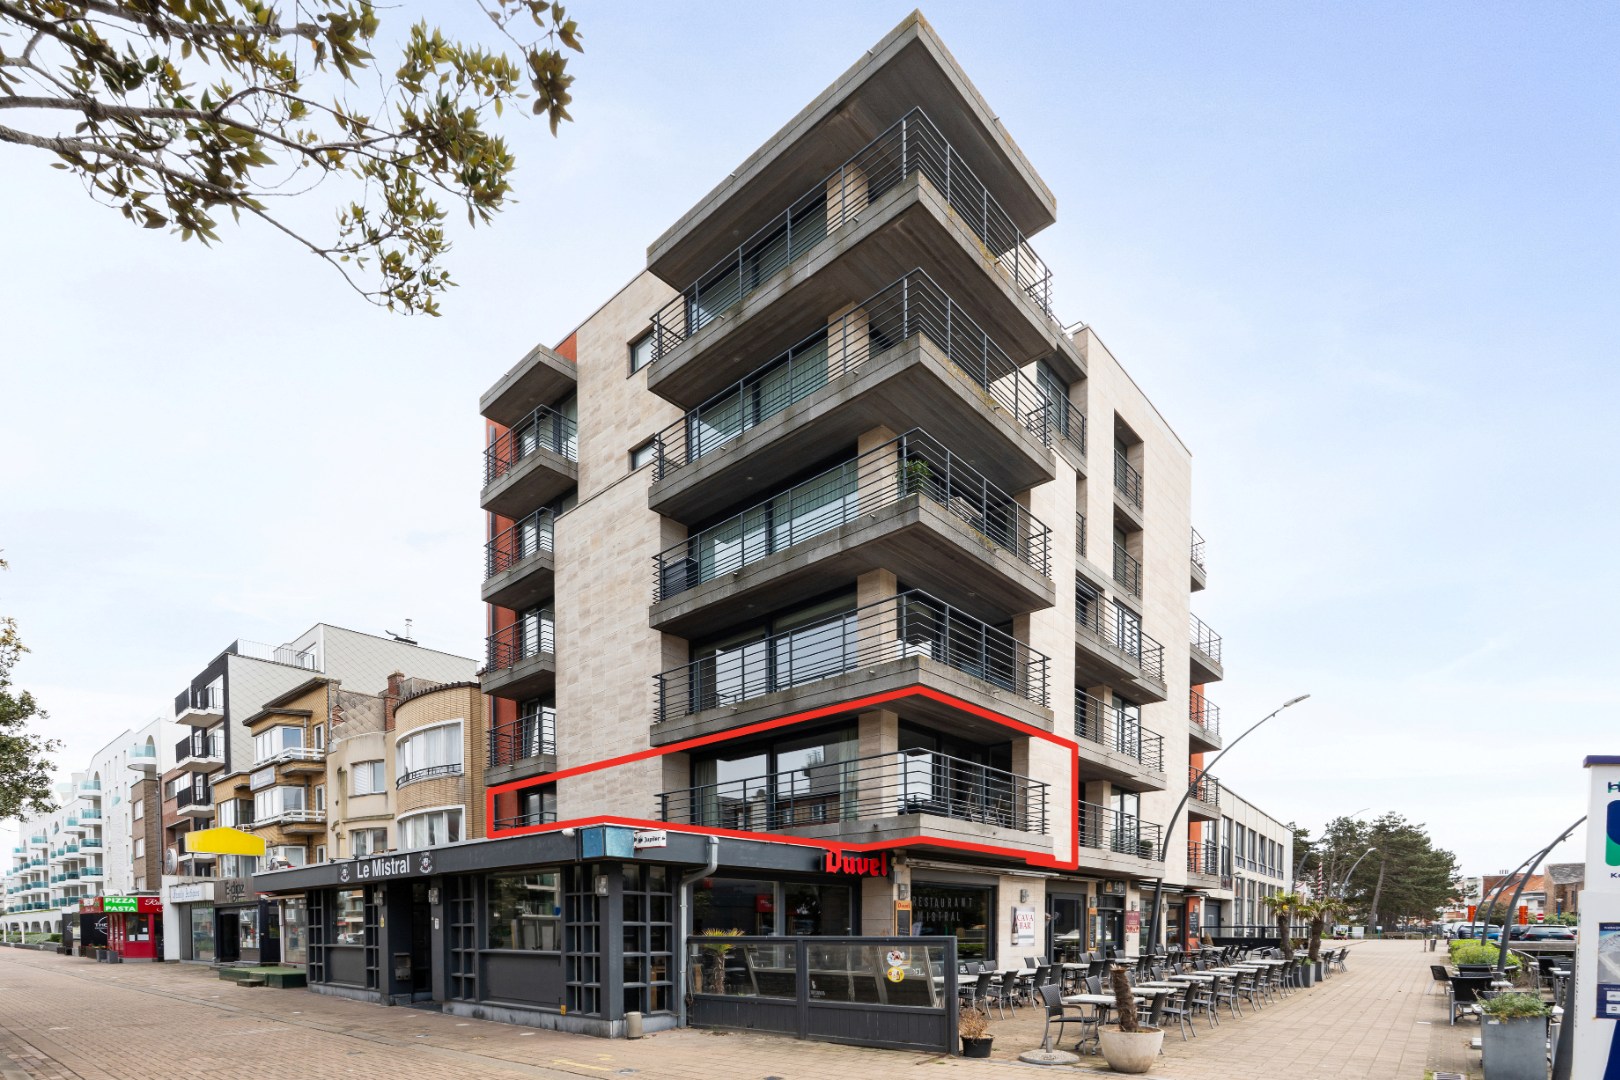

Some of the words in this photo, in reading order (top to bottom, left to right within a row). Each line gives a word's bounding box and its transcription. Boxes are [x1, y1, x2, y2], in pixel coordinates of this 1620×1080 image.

[357, 862, 370, 879] Le
[372, 855, 410, 877] Mistral
[826, 850, 887, 877] Duvel
[912, 896, 972, 908] RESTAURANT
[1017, 914, 1034, 922] CAVA
